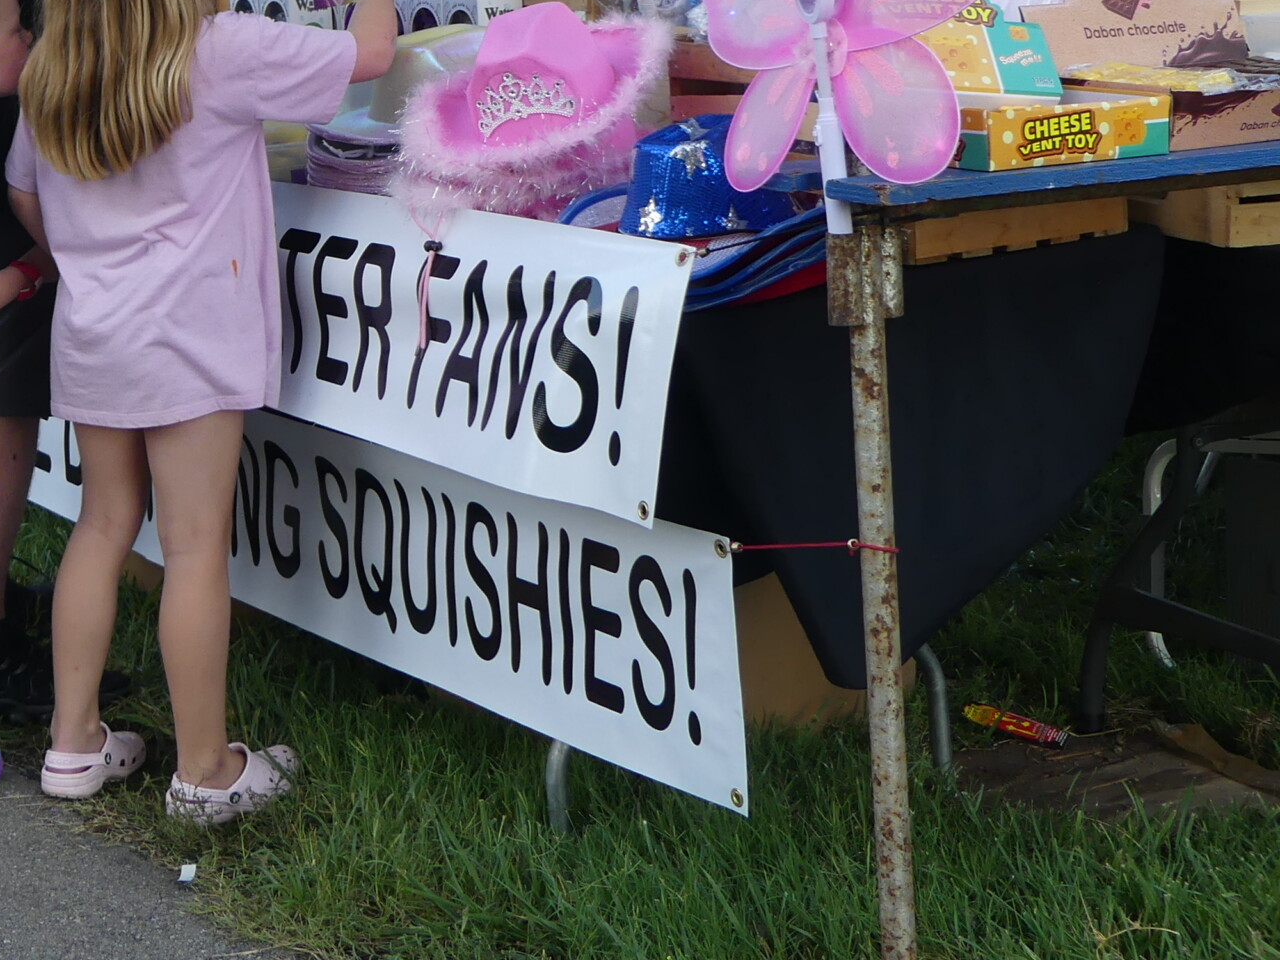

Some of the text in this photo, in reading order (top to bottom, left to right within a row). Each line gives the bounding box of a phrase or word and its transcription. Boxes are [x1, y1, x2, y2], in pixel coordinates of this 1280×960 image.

[1084, 21, 1187, 40] Daban chocolate
[1023, 112, 1092, 140] CHEESE
[1240, 120, 1270, 131] Daban
[1019, 134, 1098, 155] VENT TOY
[278, 226, 640, 468] TER FANS!
[231, 432, 703, 747] NG SQUISHIES!
